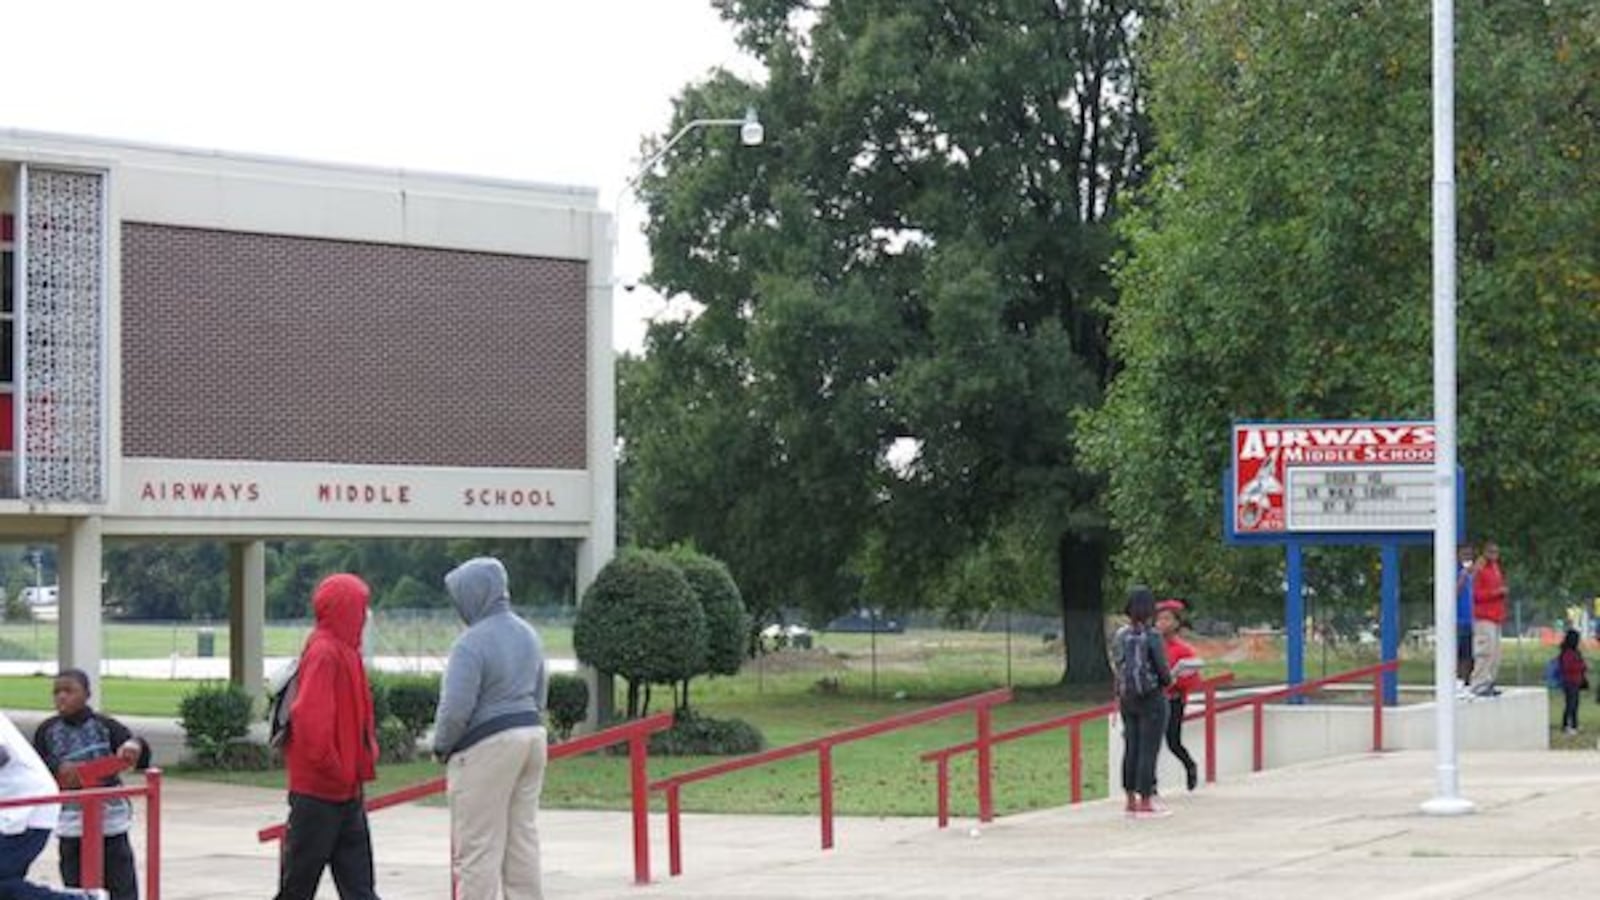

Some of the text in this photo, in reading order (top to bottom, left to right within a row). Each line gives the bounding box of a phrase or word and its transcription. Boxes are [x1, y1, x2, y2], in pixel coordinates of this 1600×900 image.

[1240, 427, 1435, 460] AIRWAYS
[1286, 446, 1435, 462] MIDDLE SCHOO
[141, 482, 557, 508] AIRWAYS MIDDLE SCHOOL
